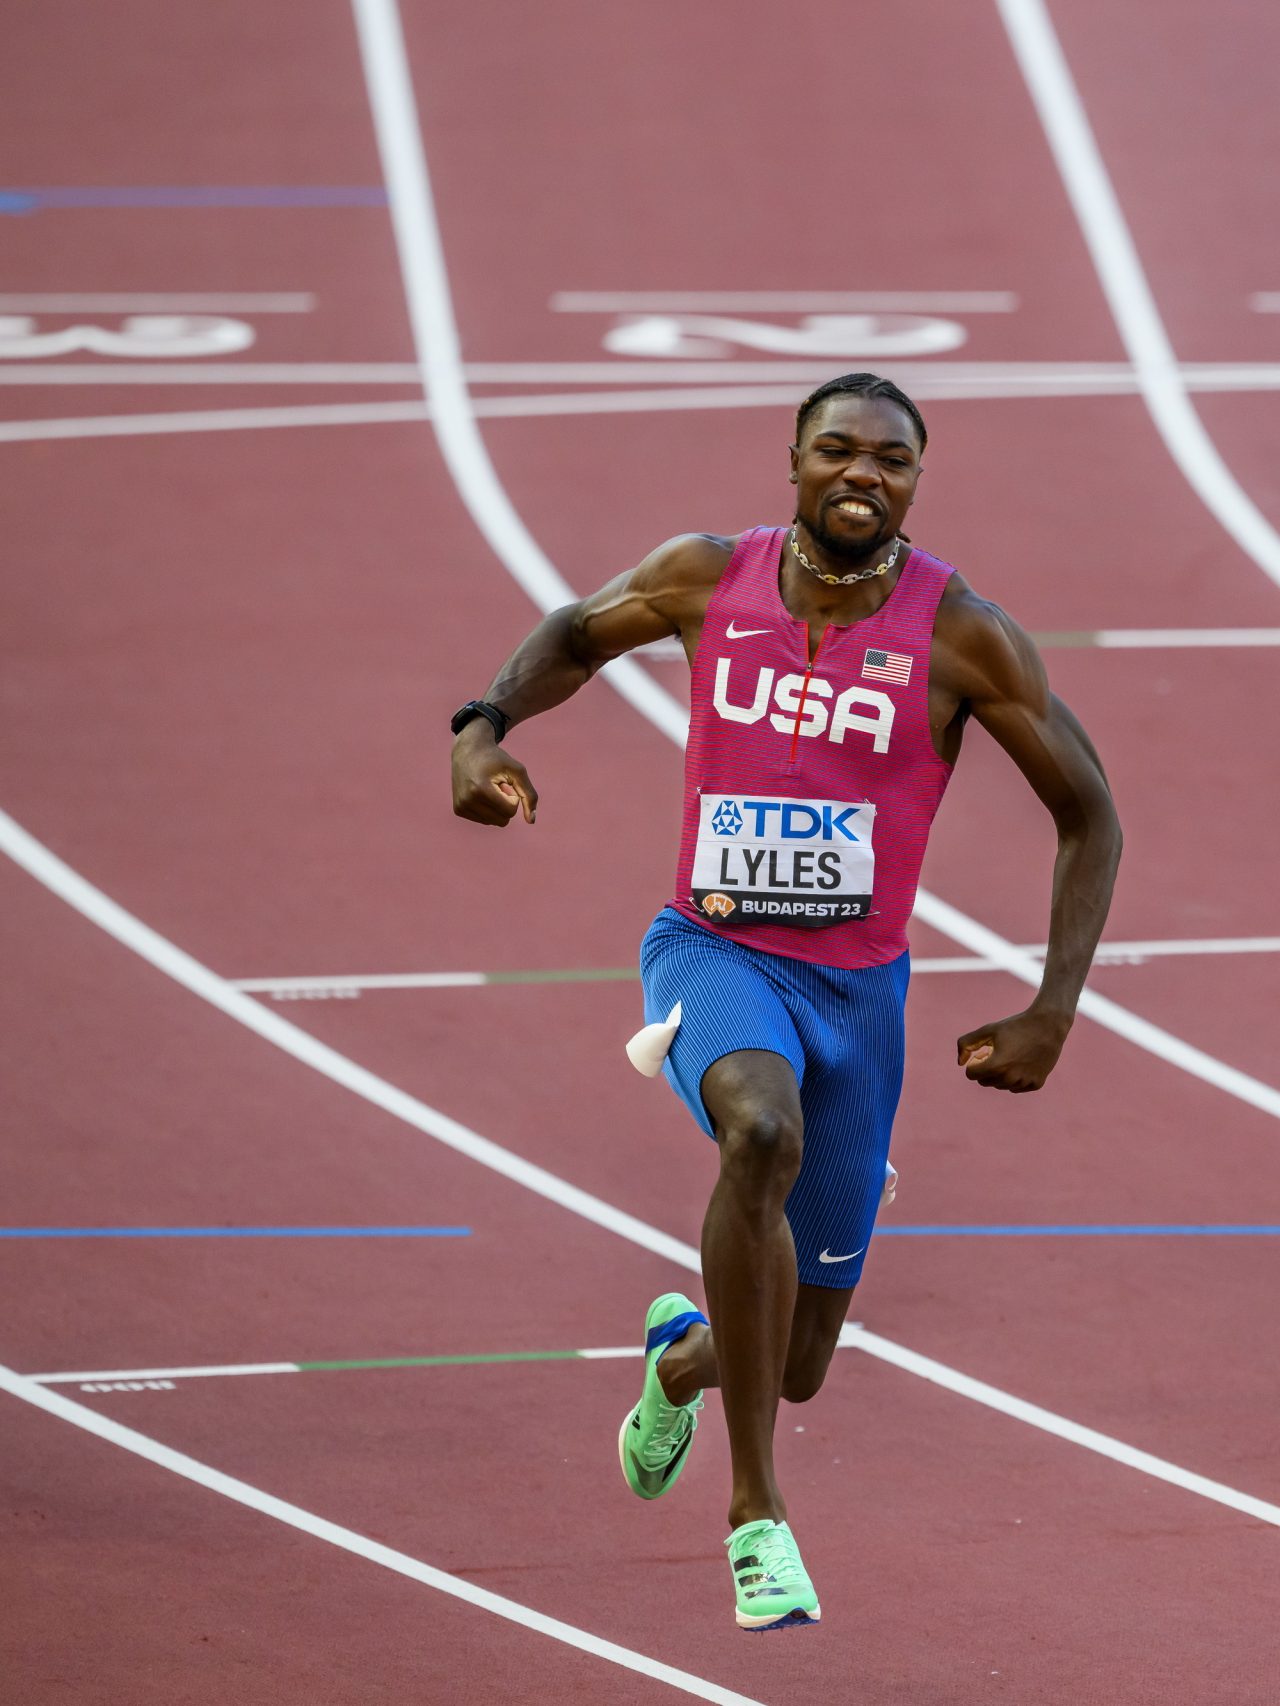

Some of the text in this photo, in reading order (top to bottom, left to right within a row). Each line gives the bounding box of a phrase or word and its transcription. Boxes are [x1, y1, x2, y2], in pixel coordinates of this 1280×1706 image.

[602, 313, 968, 357] 2
[713, 657, 896, 754] USA
[743, 801, 862, 842] TDK
[719, 847, 842, 890] LYLES
[741, 900, 861, 917] BUDAPEST 23
